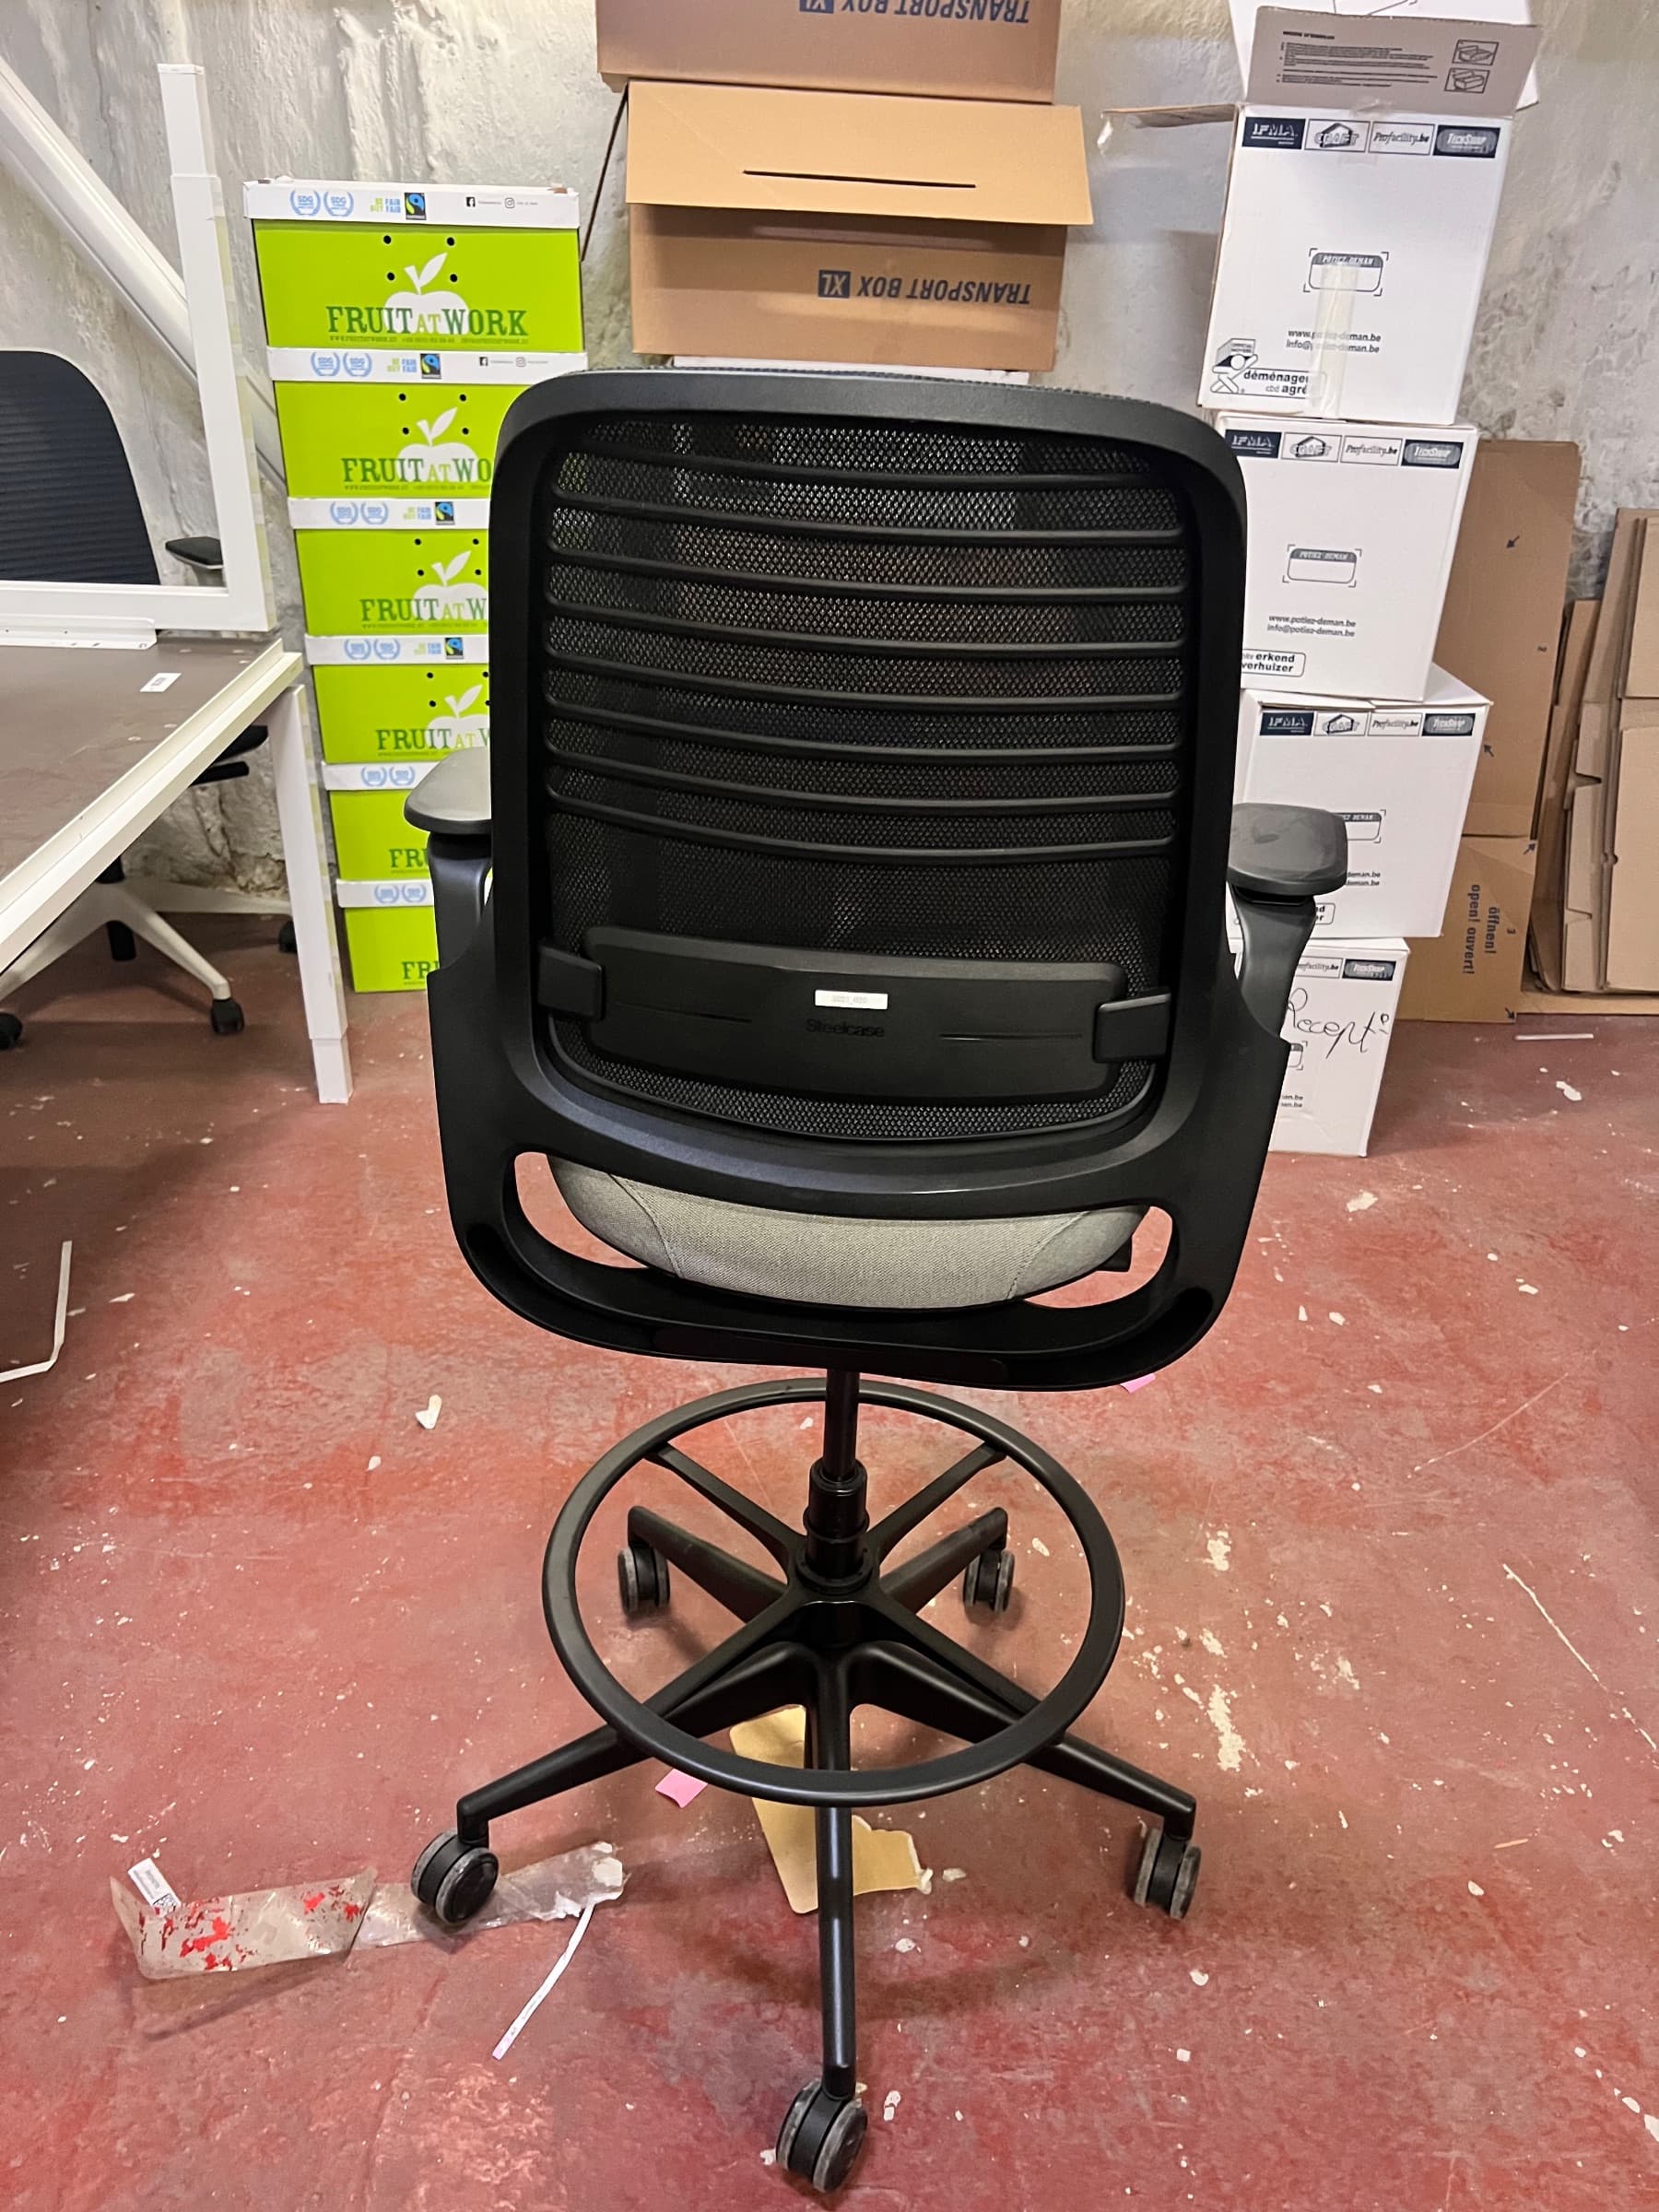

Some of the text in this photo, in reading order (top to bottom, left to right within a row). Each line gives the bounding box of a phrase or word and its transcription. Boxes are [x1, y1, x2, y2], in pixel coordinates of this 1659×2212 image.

[893, 0, 1030, 23] TRANSPORT
[821, 273, 1031, 305] TRANSPORT BOX XL
[325, 306, 413, 334] FRUIT
[441, 308, 529, 336] WORK
[341, 457, 424, 482] FRUIT
[451, 457, 492, 482] WO
[359, 598, 440, 621] FRUIT
[375, 728, 452, 750] FRUIT
[1463, 884, 1481, 974] open! ouvert!
[1484, 907, 1500, 954] öffnen!
[806, 1018, 886, 1038] Steelcase
